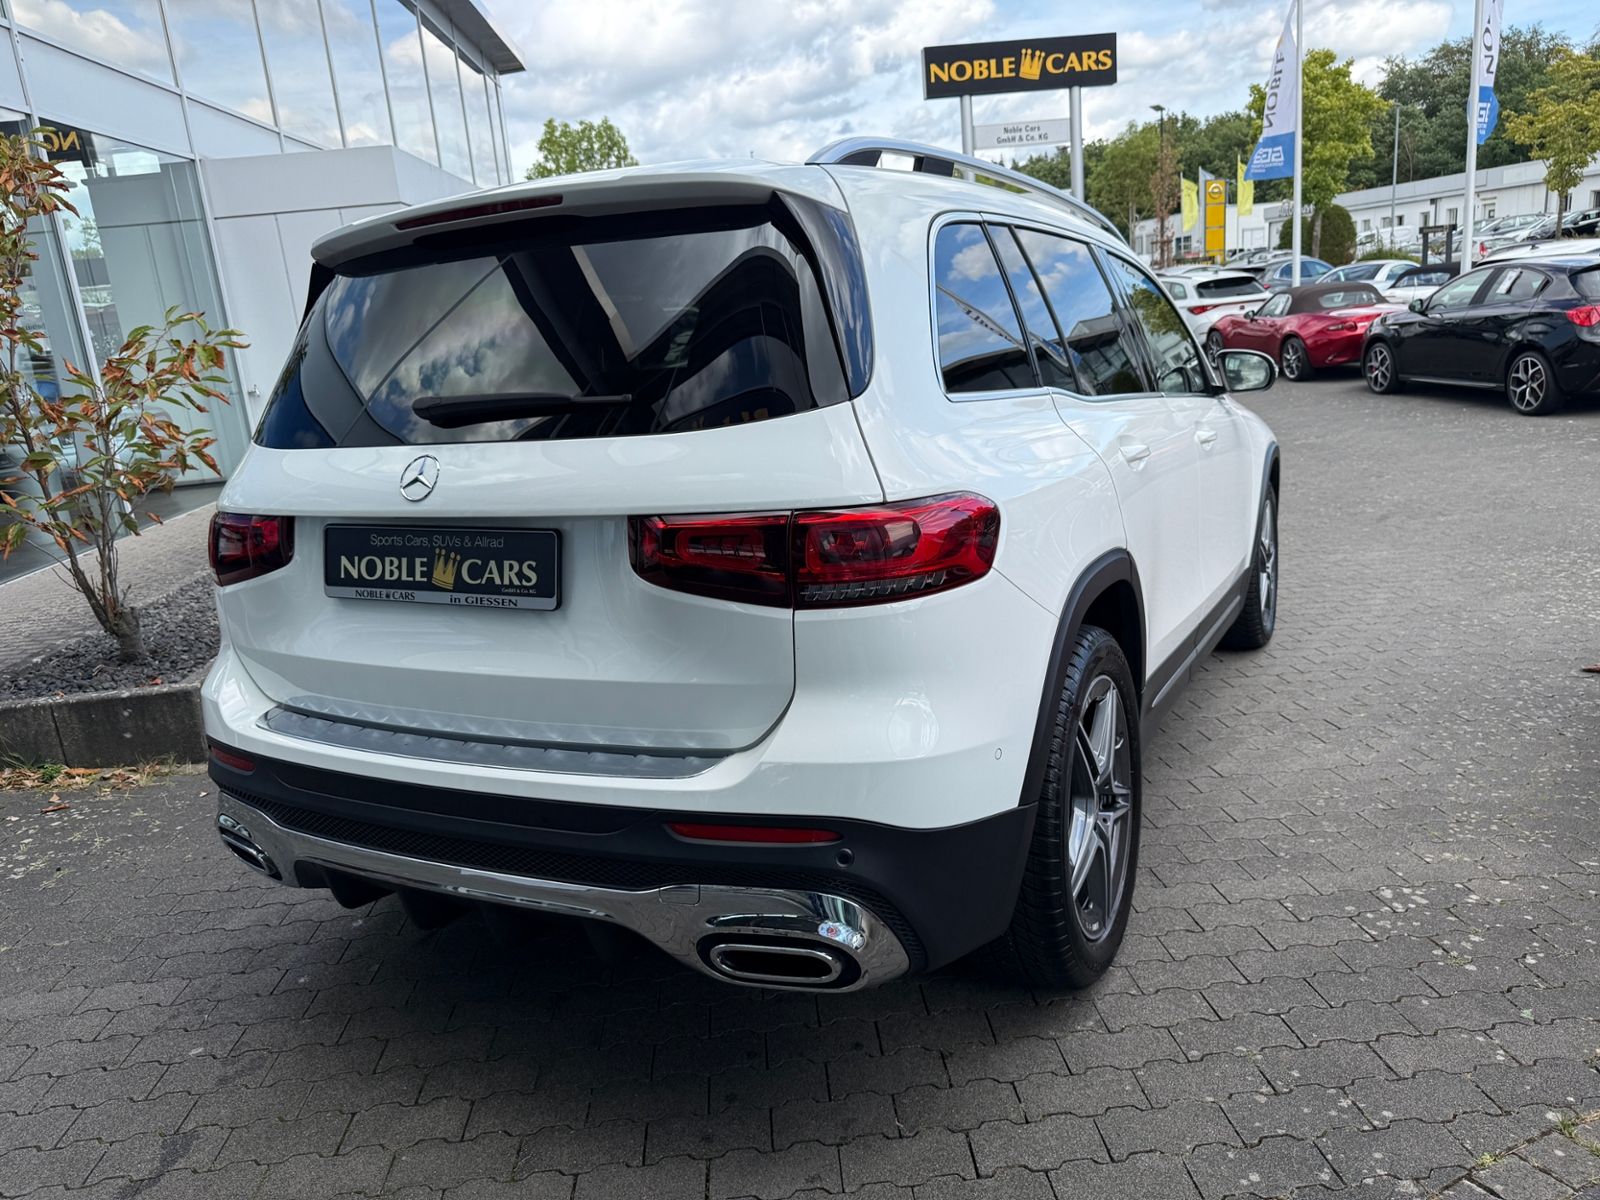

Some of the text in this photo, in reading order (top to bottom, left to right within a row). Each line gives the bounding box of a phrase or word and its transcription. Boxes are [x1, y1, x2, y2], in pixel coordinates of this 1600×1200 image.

[930, 50, 1112, 83] NOBLE CARS
[1003, 124, 1041, 134] Noble Cars
[996, 135, 1016, 144] GmbH
[1018, 134, 1024, 142] &
[1038, 132, 1049, 140] KG
[370, 533, 504, 548] Sports Cars, SUVs & Allrad
[340, 555, 538, 587] NOBLE CARS
[355, 588, 416, 601] NOBLE CARS
[450, 594, 518, 608] in GIESSEN
